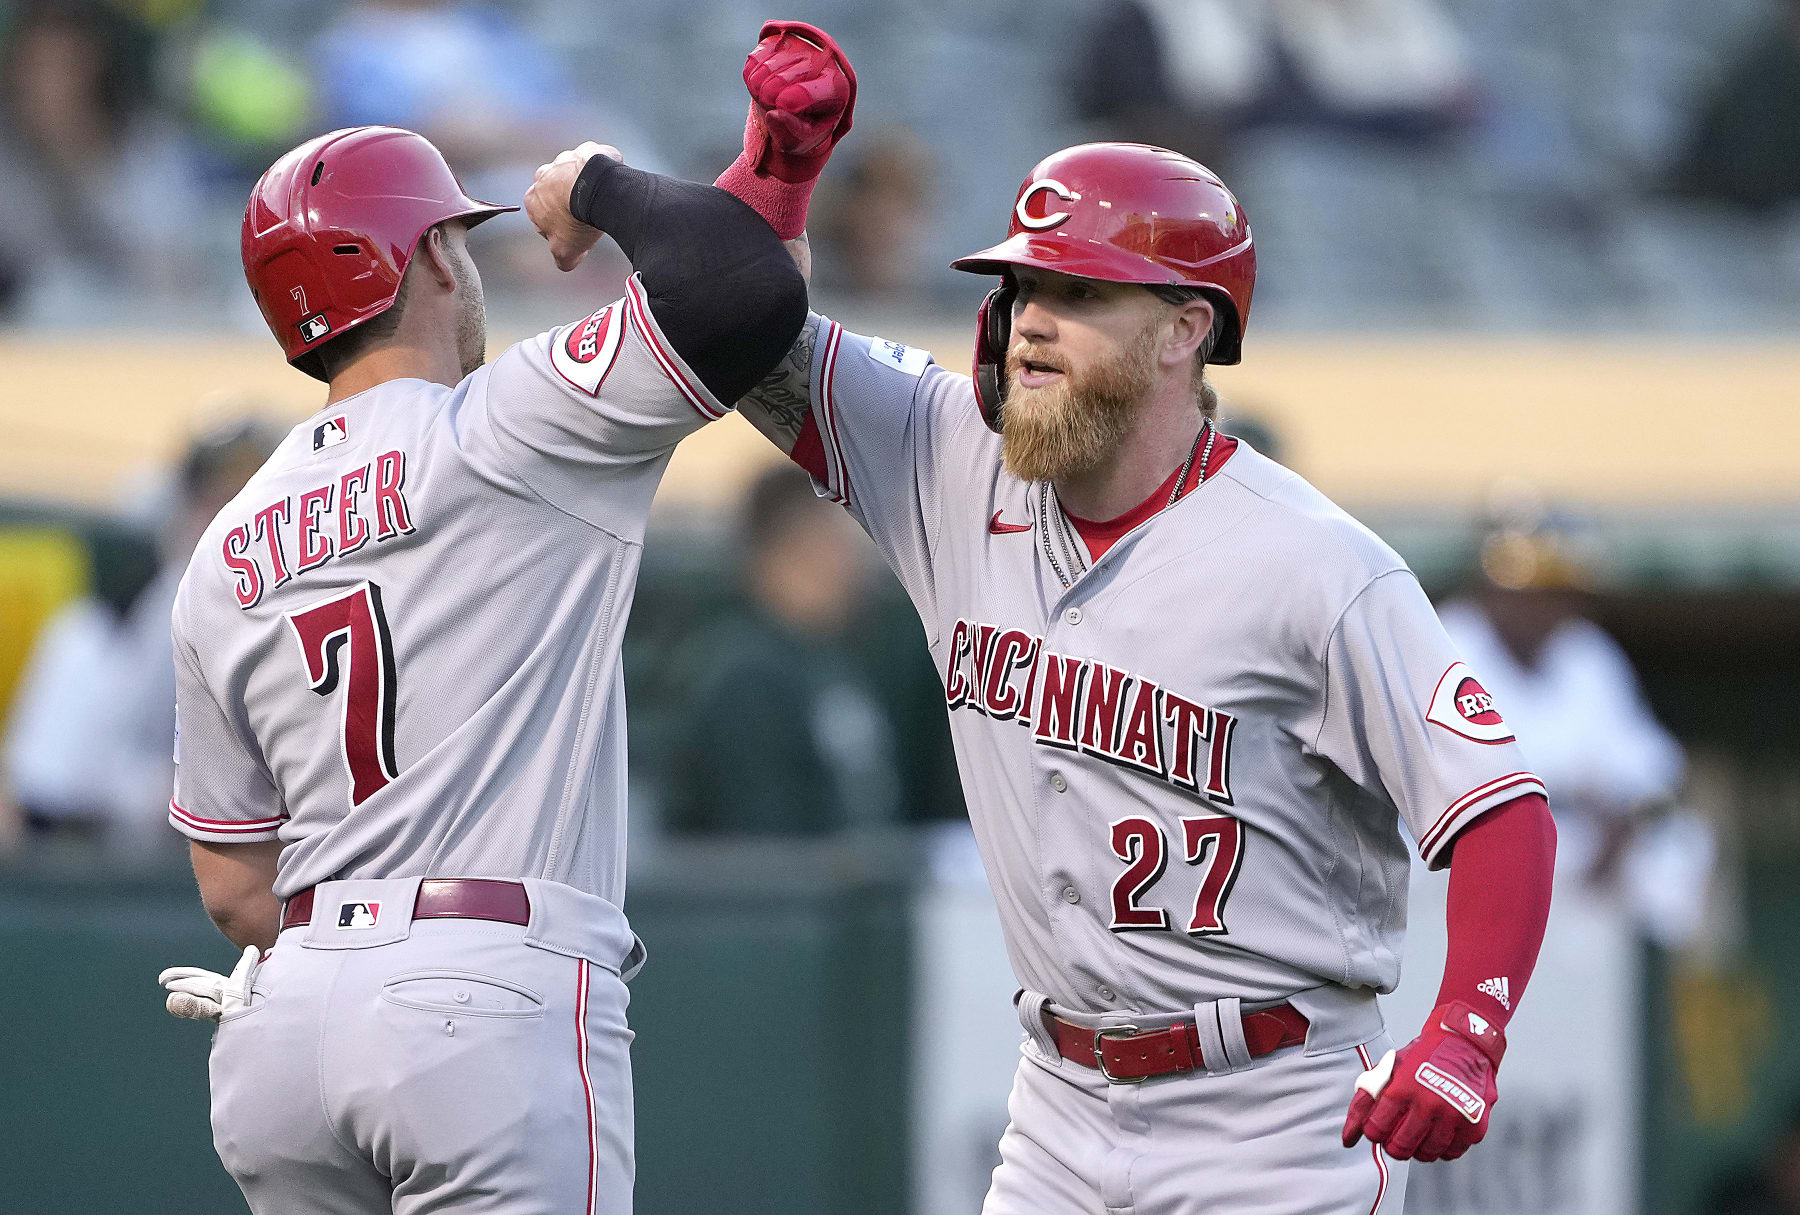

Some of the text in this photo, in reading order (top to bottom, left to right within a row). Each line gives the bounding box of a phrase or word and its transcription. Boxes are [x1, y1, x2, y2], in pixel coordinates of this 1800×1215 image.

[1016, 178, 1072, 231] C
[289, 285, 310, 317] 7
[578, 307, 607, 360] RED
[222, 449, 416, 610] STEER
[283, 580, 399, 808] 7
[946, 617, 1238, 806] CNCINNATI
[1109, 815, 1246, 936] 27
[1477, 982, 1510, 1010] adidas
